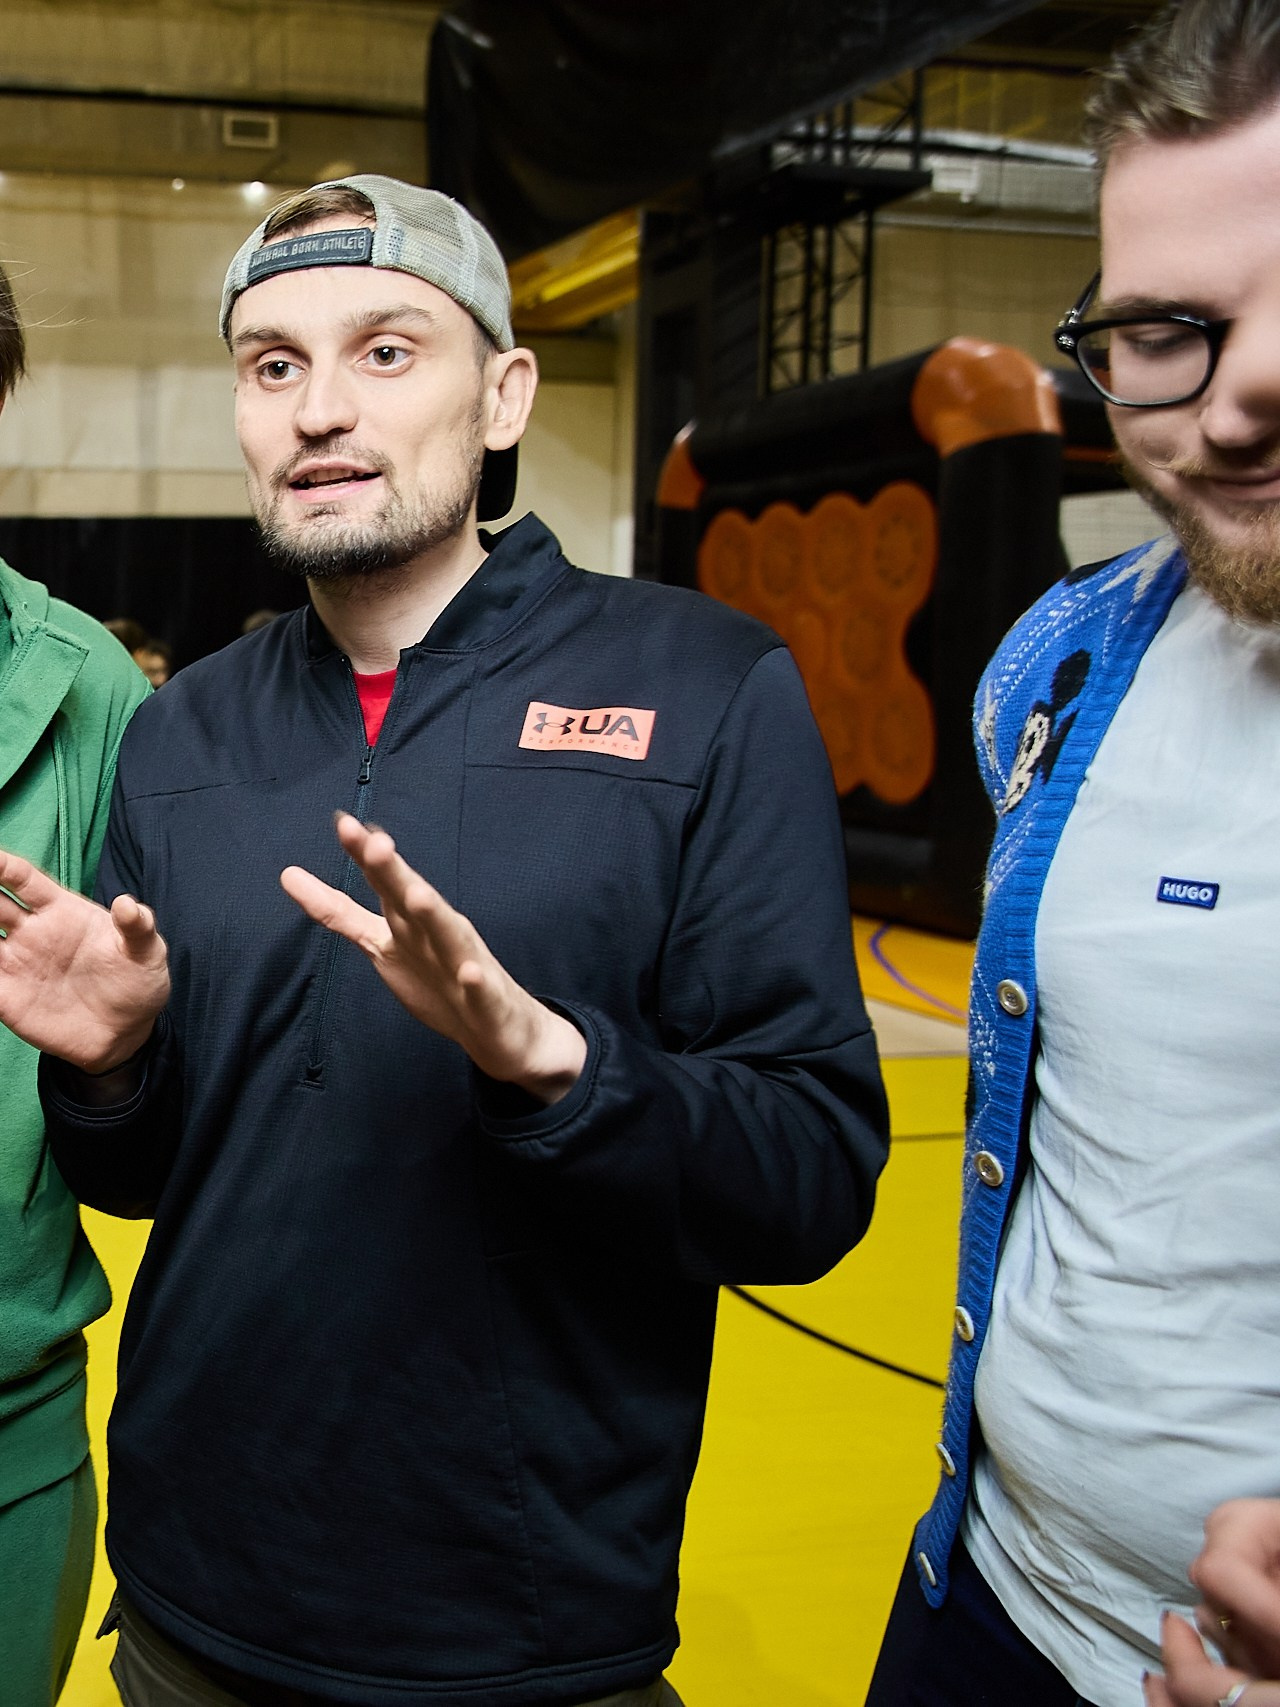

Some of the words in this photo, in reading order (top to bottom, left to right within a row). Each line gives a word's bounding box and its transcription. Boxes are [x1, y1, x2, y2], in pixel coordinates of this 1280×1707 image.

[252, 246, 289, 266] NATURAL
[291, 242, 320, 256] BORN
[322, 236, 365, 251] ATHLETE
[579, 714, 640, 742] UA
[528, 736, 640, 752] PERFORMANCE
[1162, 882, 1214, 902] HUGO
